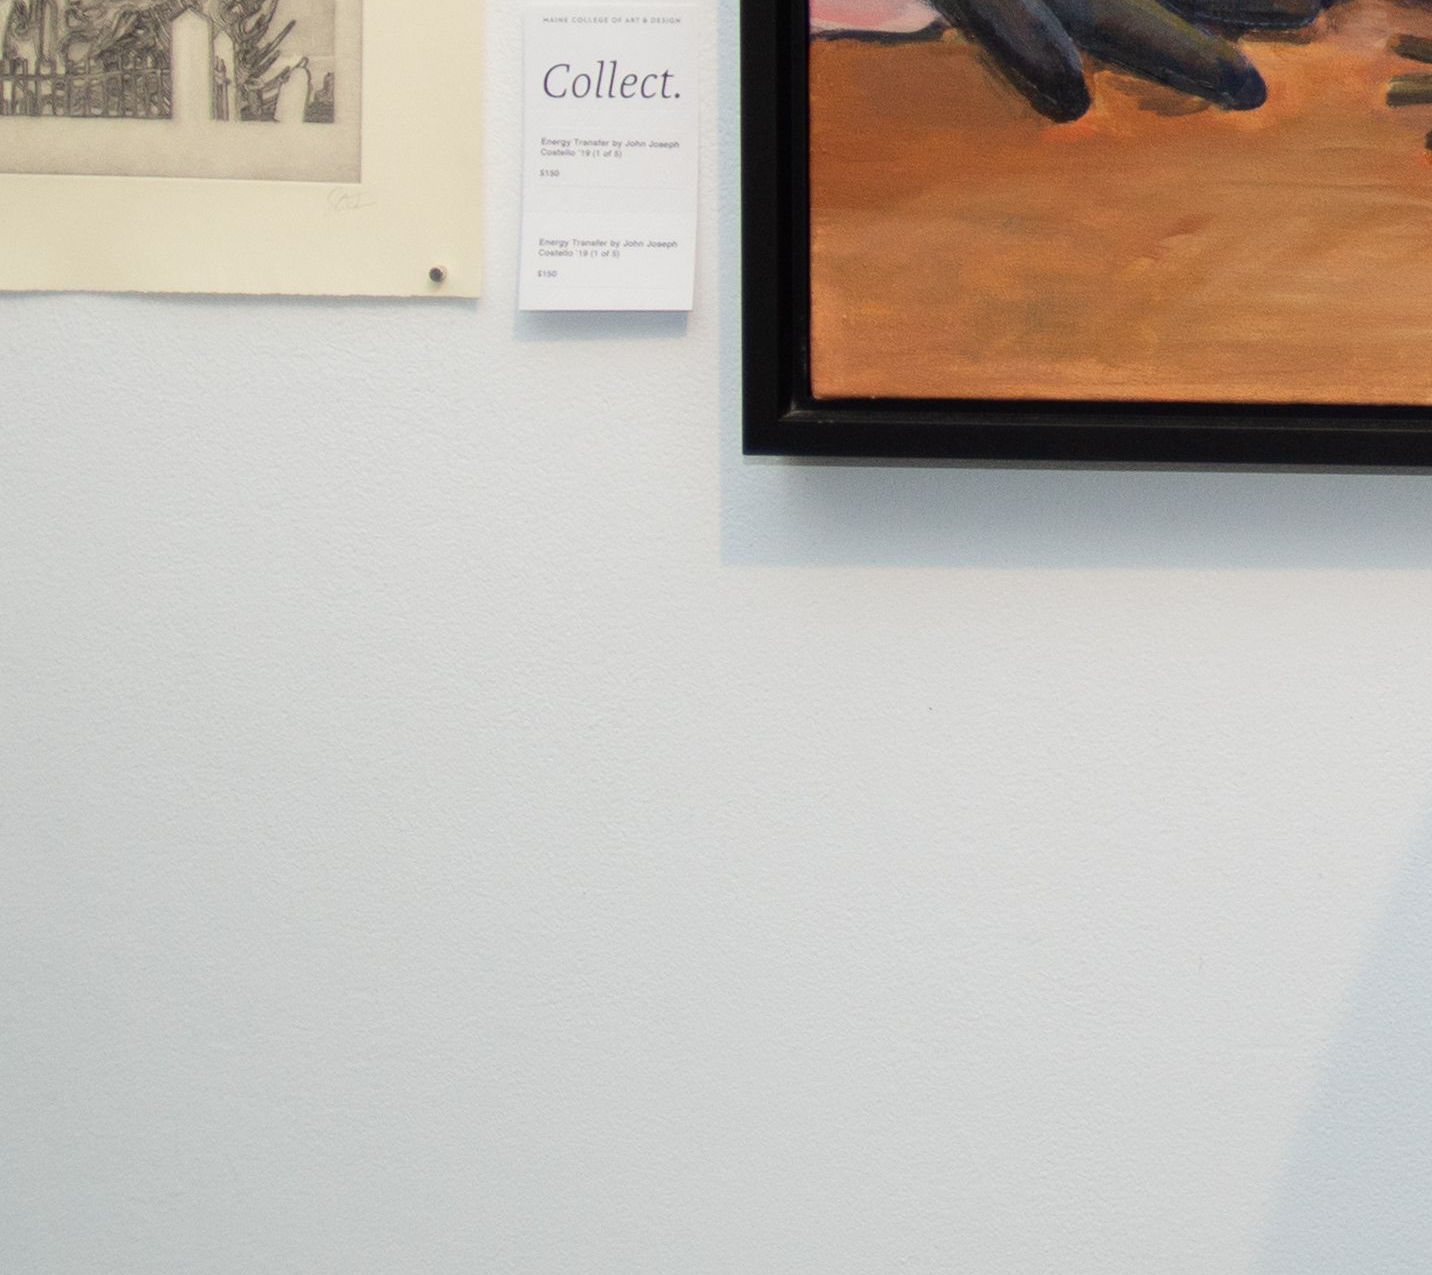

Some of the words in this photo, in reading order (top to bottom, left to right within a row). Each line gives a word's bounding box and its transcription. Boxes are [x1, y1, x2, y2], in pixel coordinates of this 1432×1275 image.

[544, 60, 680, 98] Collect.
[541, 137, 570, 147] Energy
[613, 139, 622, 148] by
[648, 141, 680, 149] Joseph
[593, 150, 600, 158] (1
[540, 169, 560, 177] $150
[539, 239, 568, 247] Energy
[573, 239, 606, 247] Transfer
[610, 239, 619, 248] by
[647, 241, 678, 249] Joseph
[538, 249, 573, 257] Costello
